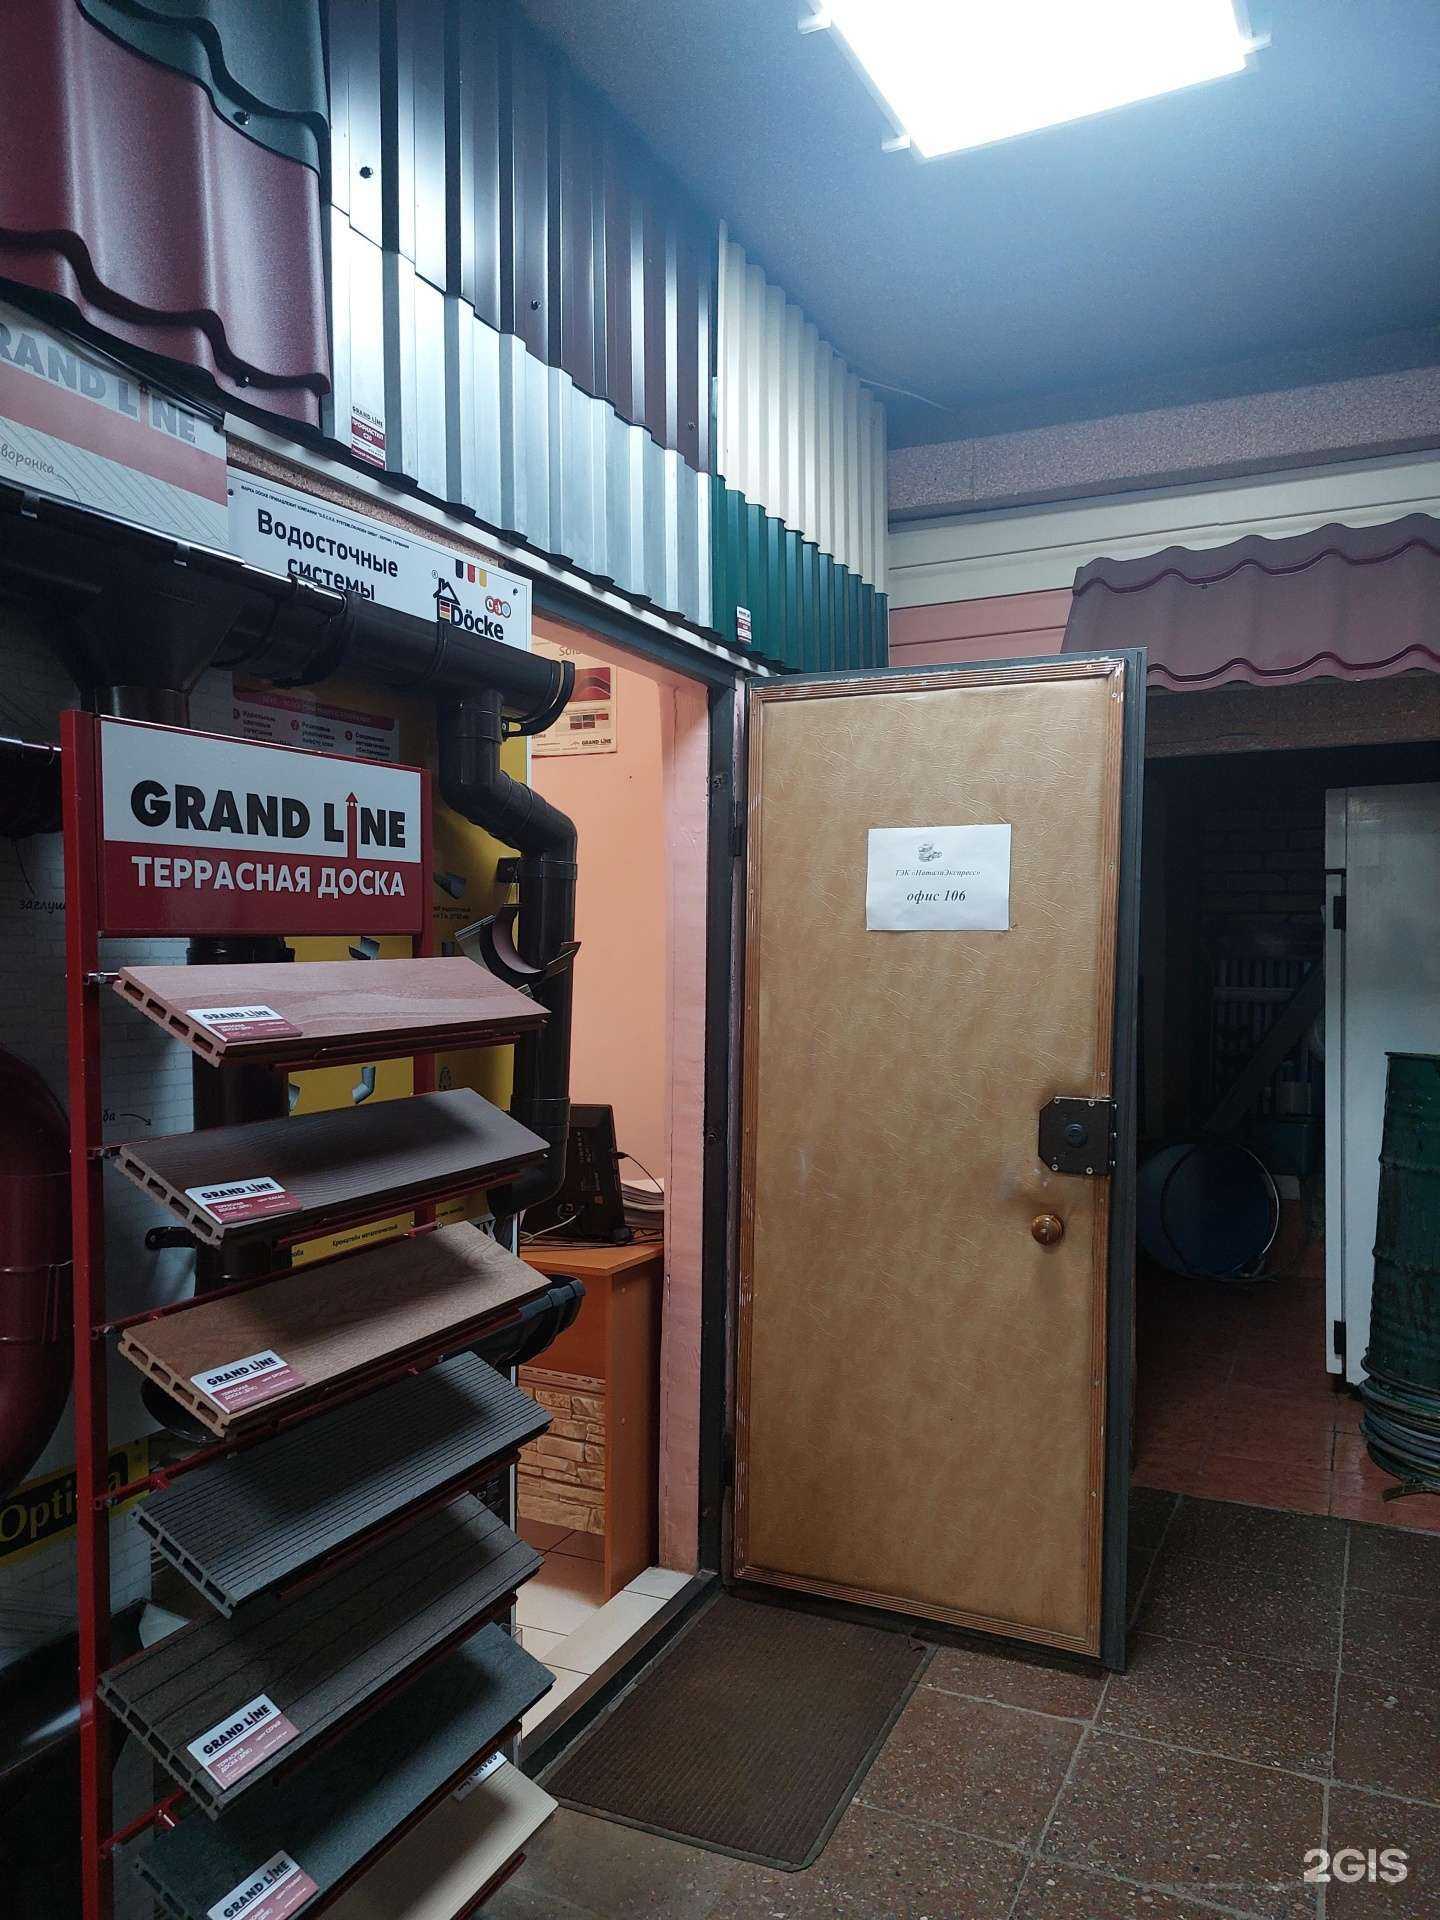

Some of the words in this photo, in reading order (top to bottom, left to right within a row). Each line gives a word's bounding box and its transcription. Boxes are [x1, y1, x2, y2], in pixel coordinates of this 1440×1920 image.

[257, 508, 398, 578] Водосточные
[287, 557, 376, 601] системы
[451, 604, 505, 641] Döcke
[130, 779, 311, 839] GRAND
[323, 792, 406, 850] LINE
[131, 855, 311, 893] ТЕРРАСНАЯ
[317, 866, 406, 899] ДОСКА
[906, 890, 940, 904] офис
[944, 889, 967, 902] 106
[202, 1012, 245, 1020] GRAND
[244, 1009, 272, 1018] LINE
[201, 1186, 246, 1200] GRAND
[246, 1182, 275, 1193] LINE
[206, 1367, 250, 1386] GRAND
[249, 1357, 277, 1371] LINE
[0, 1471, 121, 1542] Optia
[202, 1723, 245, 1755] GRAND
[244, 1704, 271, 1728] LINE
[223, 1882, 264, 1918] GRAND
[263, 1860, 290, 1884] LINE
